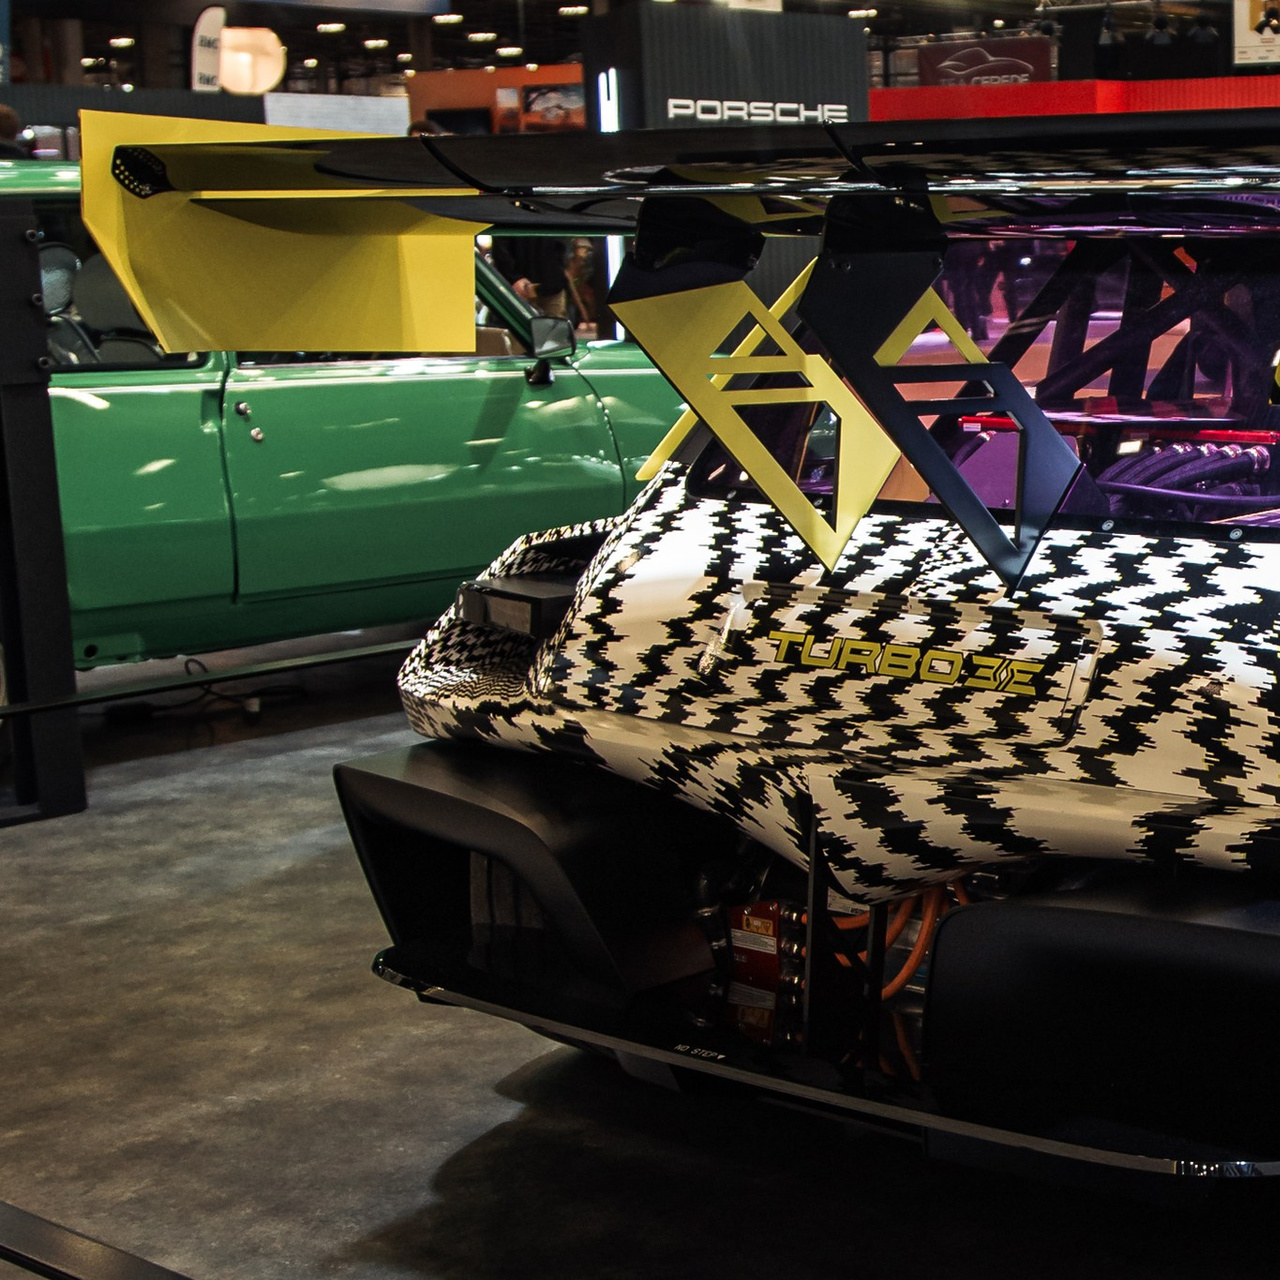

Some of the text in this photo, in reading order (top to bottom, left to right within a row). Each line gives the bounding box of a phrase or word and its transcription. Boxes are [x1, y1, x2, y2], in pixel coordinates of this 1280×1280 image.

[668, 98, 849, 123] PORSCHE
[673, 1043, 719, 1059] NO STEP
